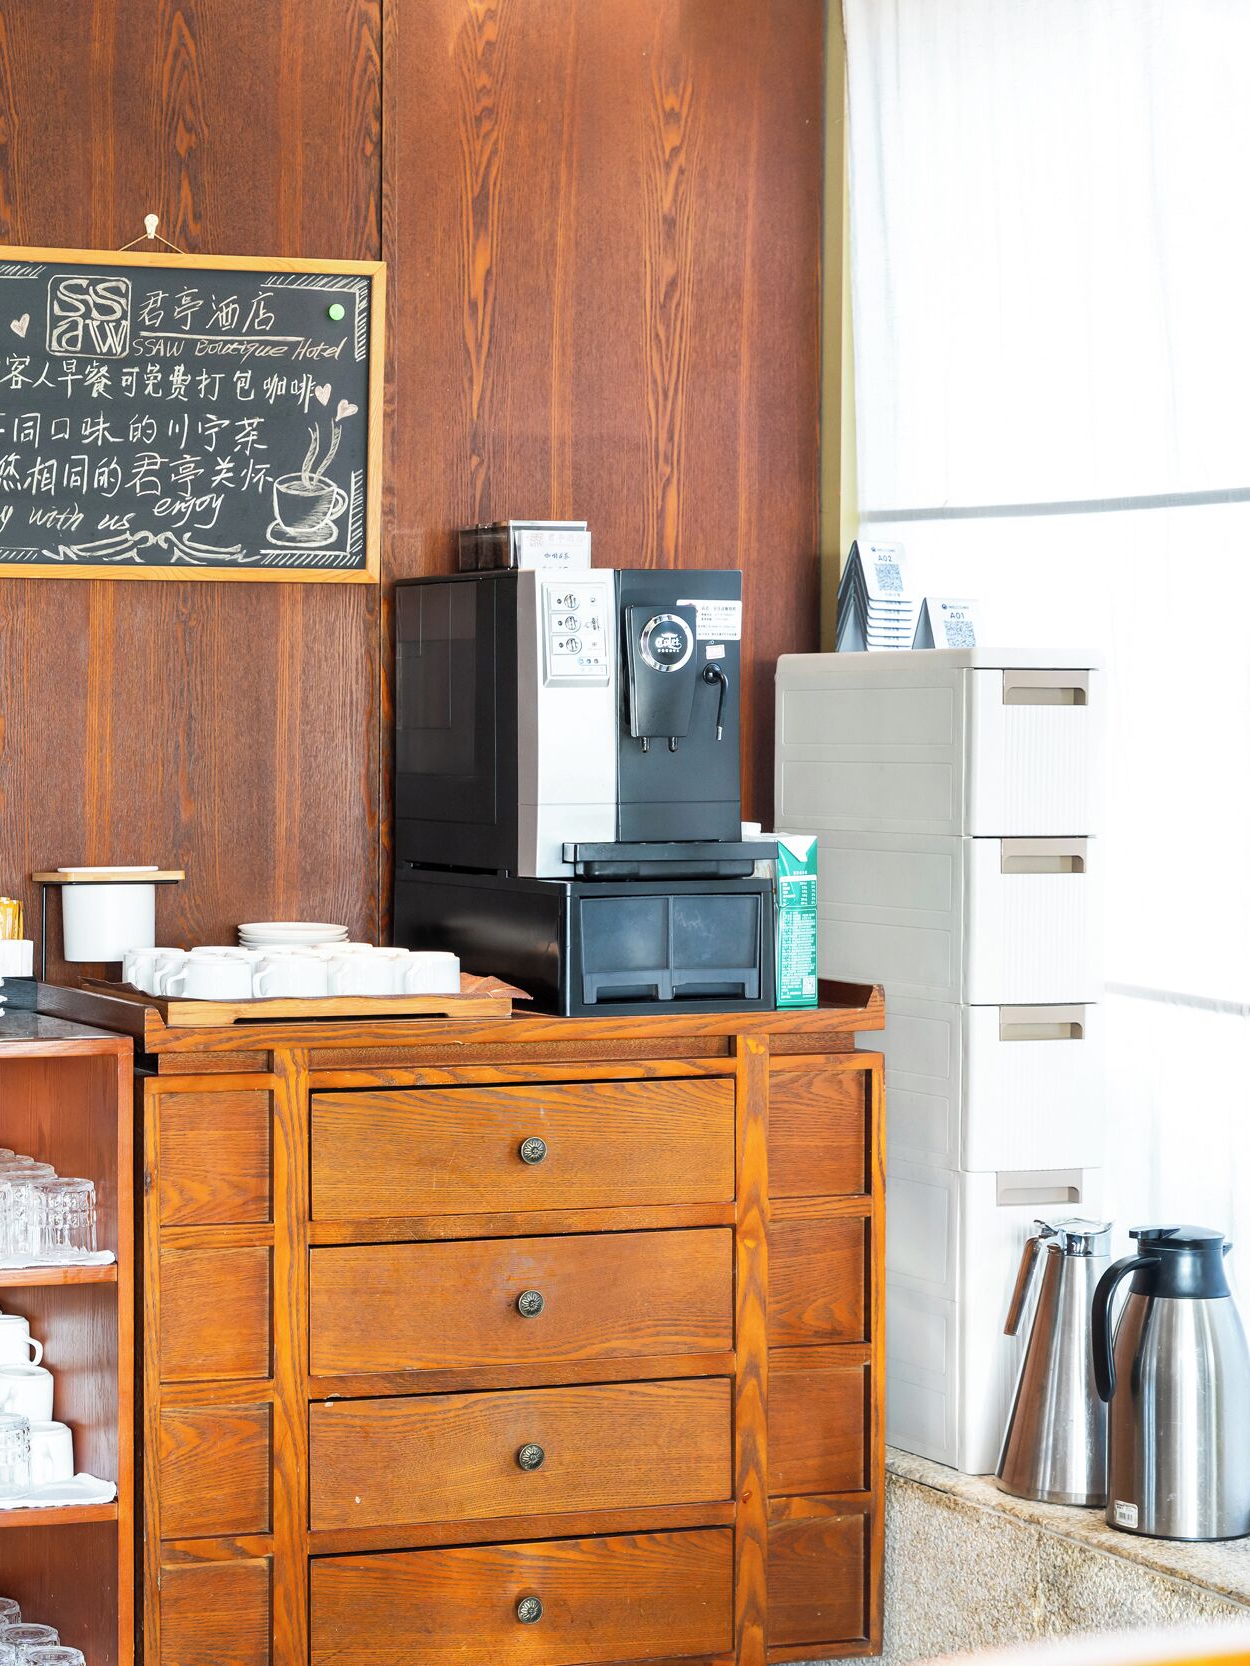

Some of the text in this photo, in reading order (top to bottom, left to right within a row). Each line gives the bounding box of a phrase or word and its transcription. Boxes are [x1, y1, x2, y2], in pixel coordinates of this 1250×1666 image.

[137, 286, 275, 333] 君亭酒店
[133, 338, 186, 357] SSAW
[291, 336, 347, 361] Hotel
[28, 502, 85, 531] with
[97, 511, 137, 531] us
[152, 493, 225, 529] enjoy
[878, 554, 892, 562] A02
